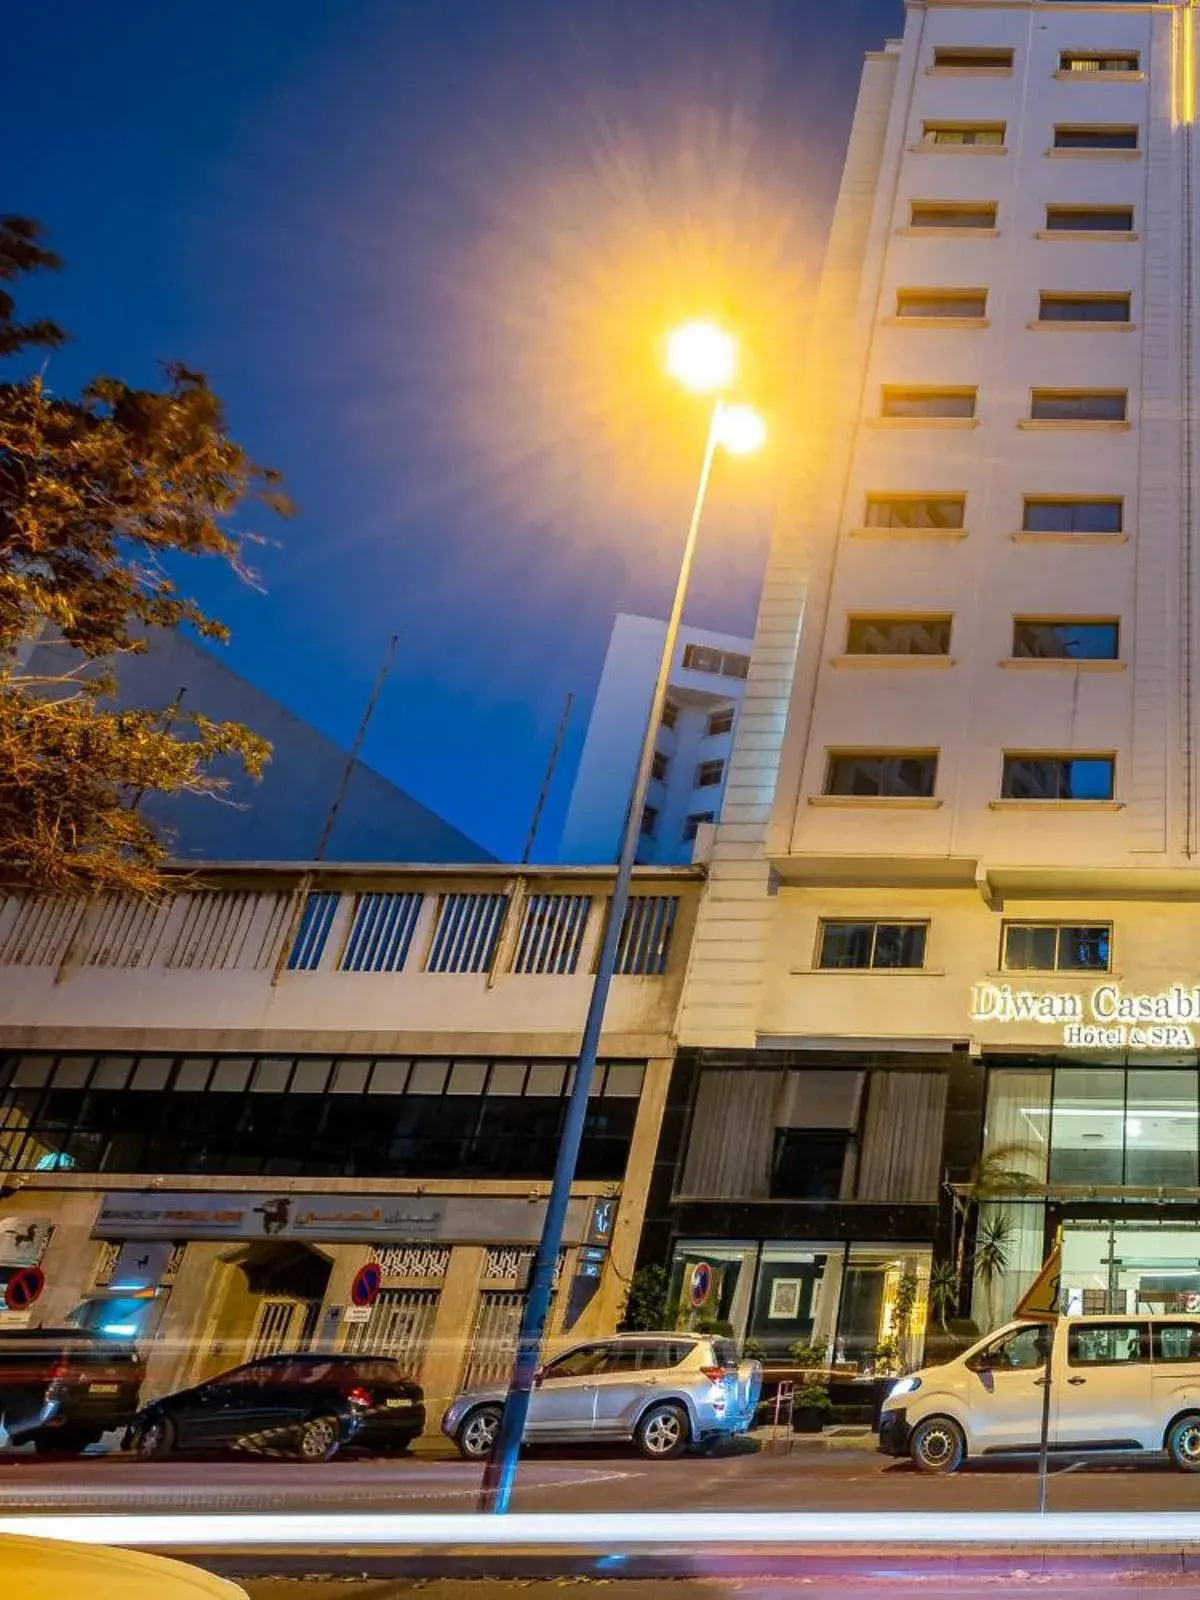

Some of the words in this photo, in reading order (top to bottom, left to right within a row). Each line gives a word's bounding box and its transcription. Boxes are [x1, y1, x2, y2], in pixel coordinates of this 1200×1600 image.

[972, 986, 1079, 1019] Diwan
[1131, 1030, 1146, 1044] &
[1151, 1027, 1191, 1046] SPA
